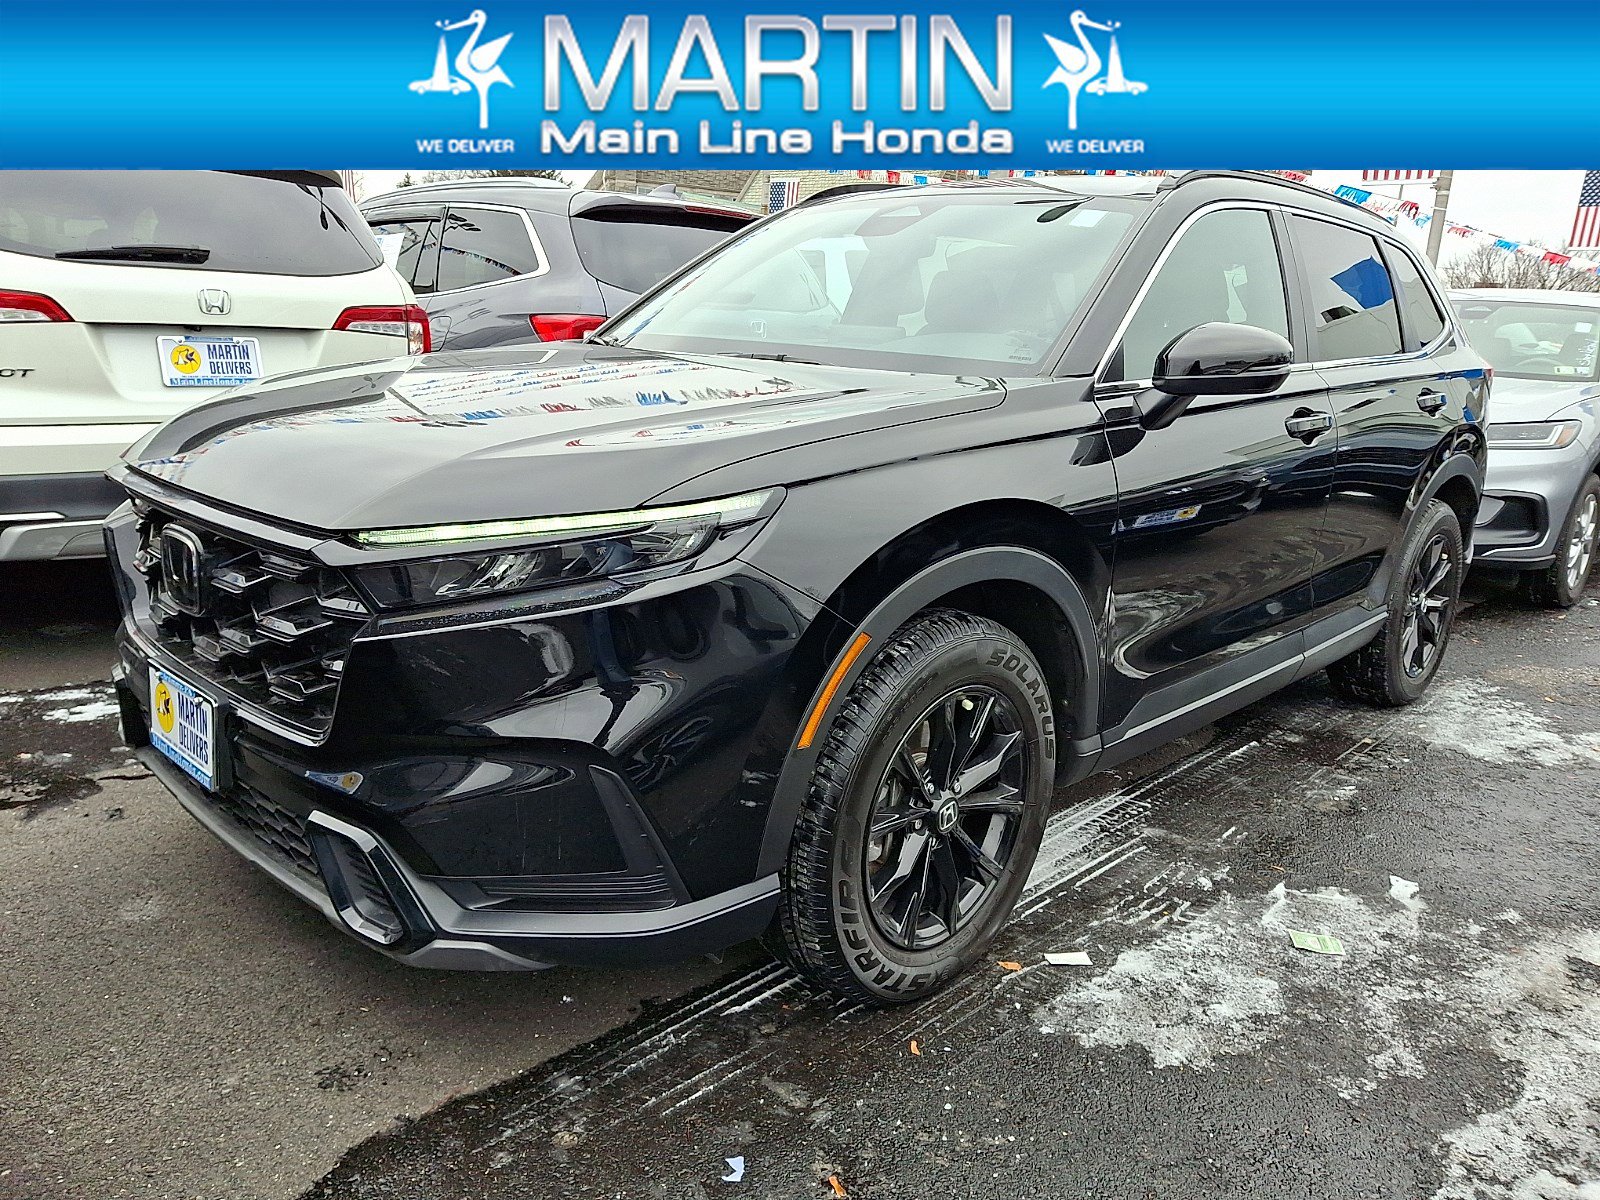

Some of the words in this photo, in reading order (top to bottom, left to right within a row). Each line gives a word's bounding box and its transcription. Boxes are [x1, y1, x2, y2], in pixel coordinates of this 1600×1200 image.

[207, 344, 250, 360] MARTIN
[209, 361, 252, 375] DELIVERS
[178, 692, 208, 738] MARTIN
[986, 648, 1055, 760] SOLARUS
[178, 722, 209, 765] DELIVERS
